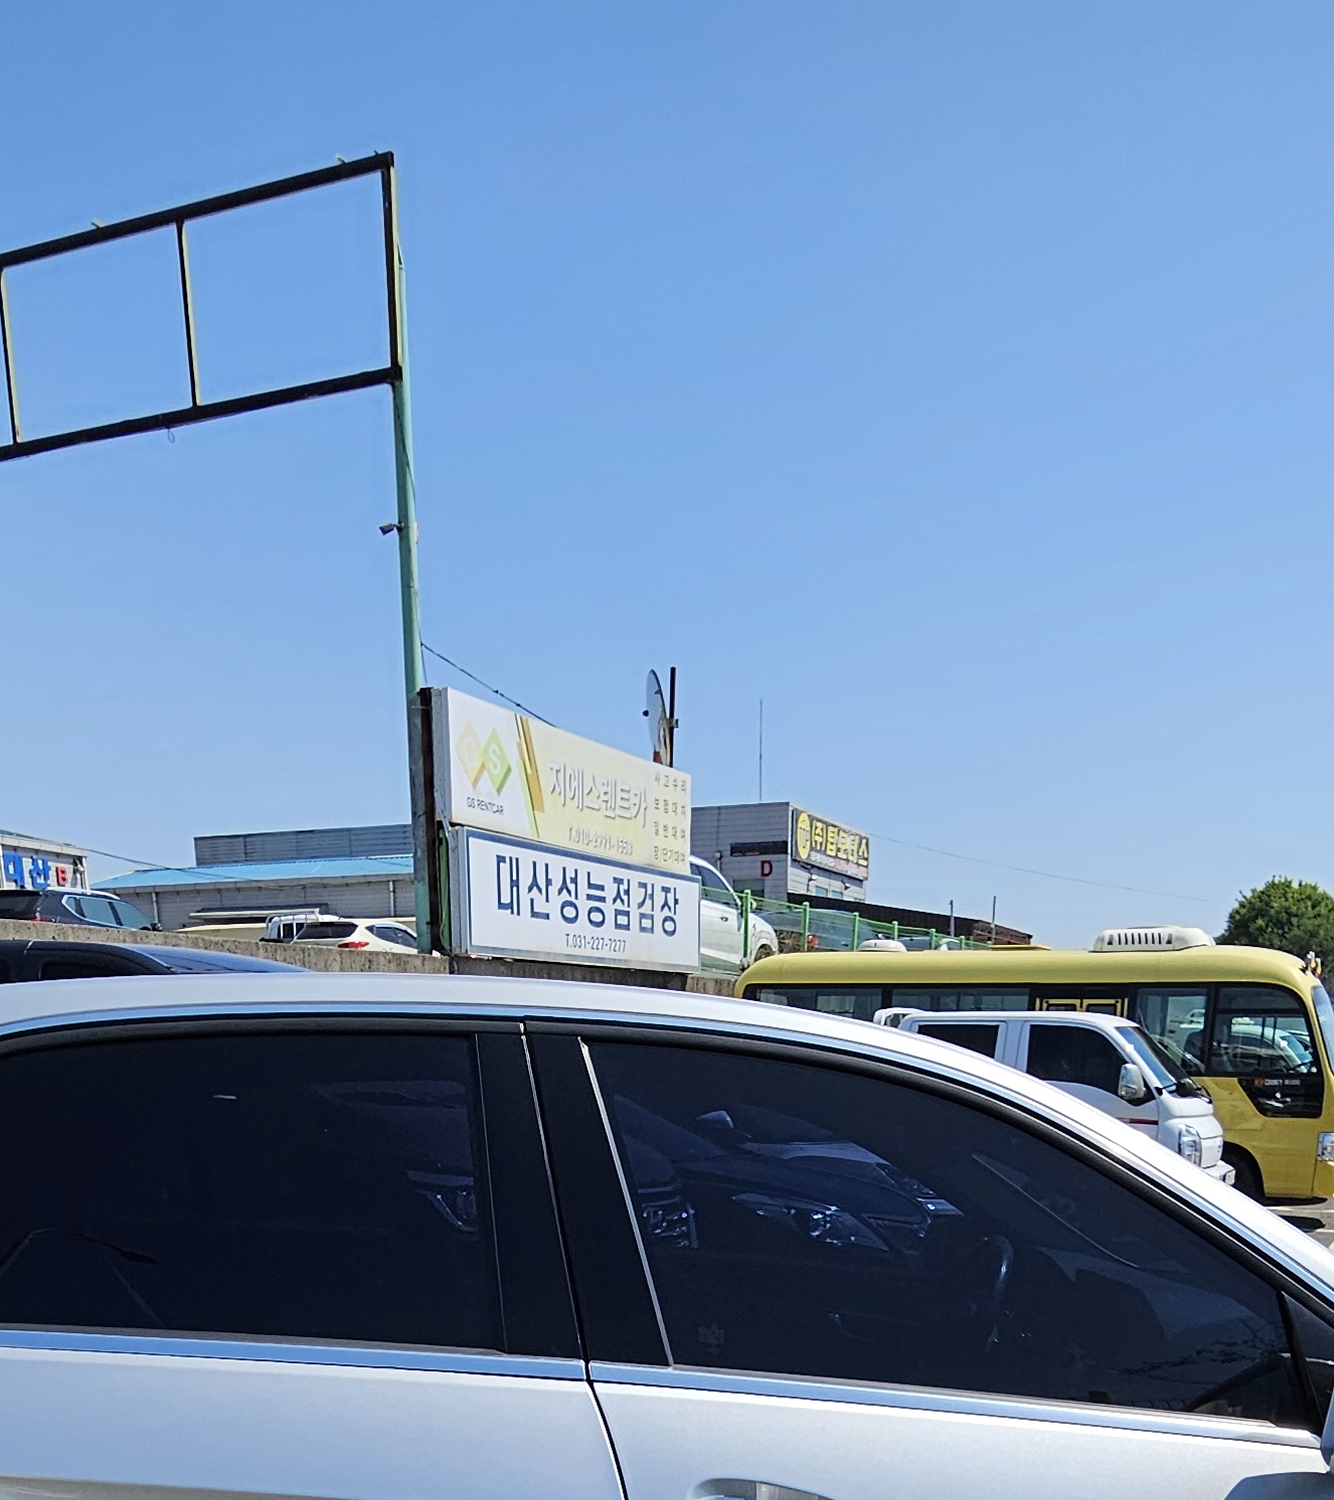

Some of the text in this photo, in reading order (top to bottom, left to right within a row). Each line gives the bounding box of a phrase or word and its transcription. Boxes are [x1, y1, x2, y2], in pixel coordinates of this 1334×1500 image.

[549, 761, 648, 829] 지에스렌트카
[476, 798, 505, 816] RENTCAR
[760, 860, 773, 877] D
[495, 854, 679, 937] 대산성능점검장
[565, 933, 627, 953] T.031-227-7277
